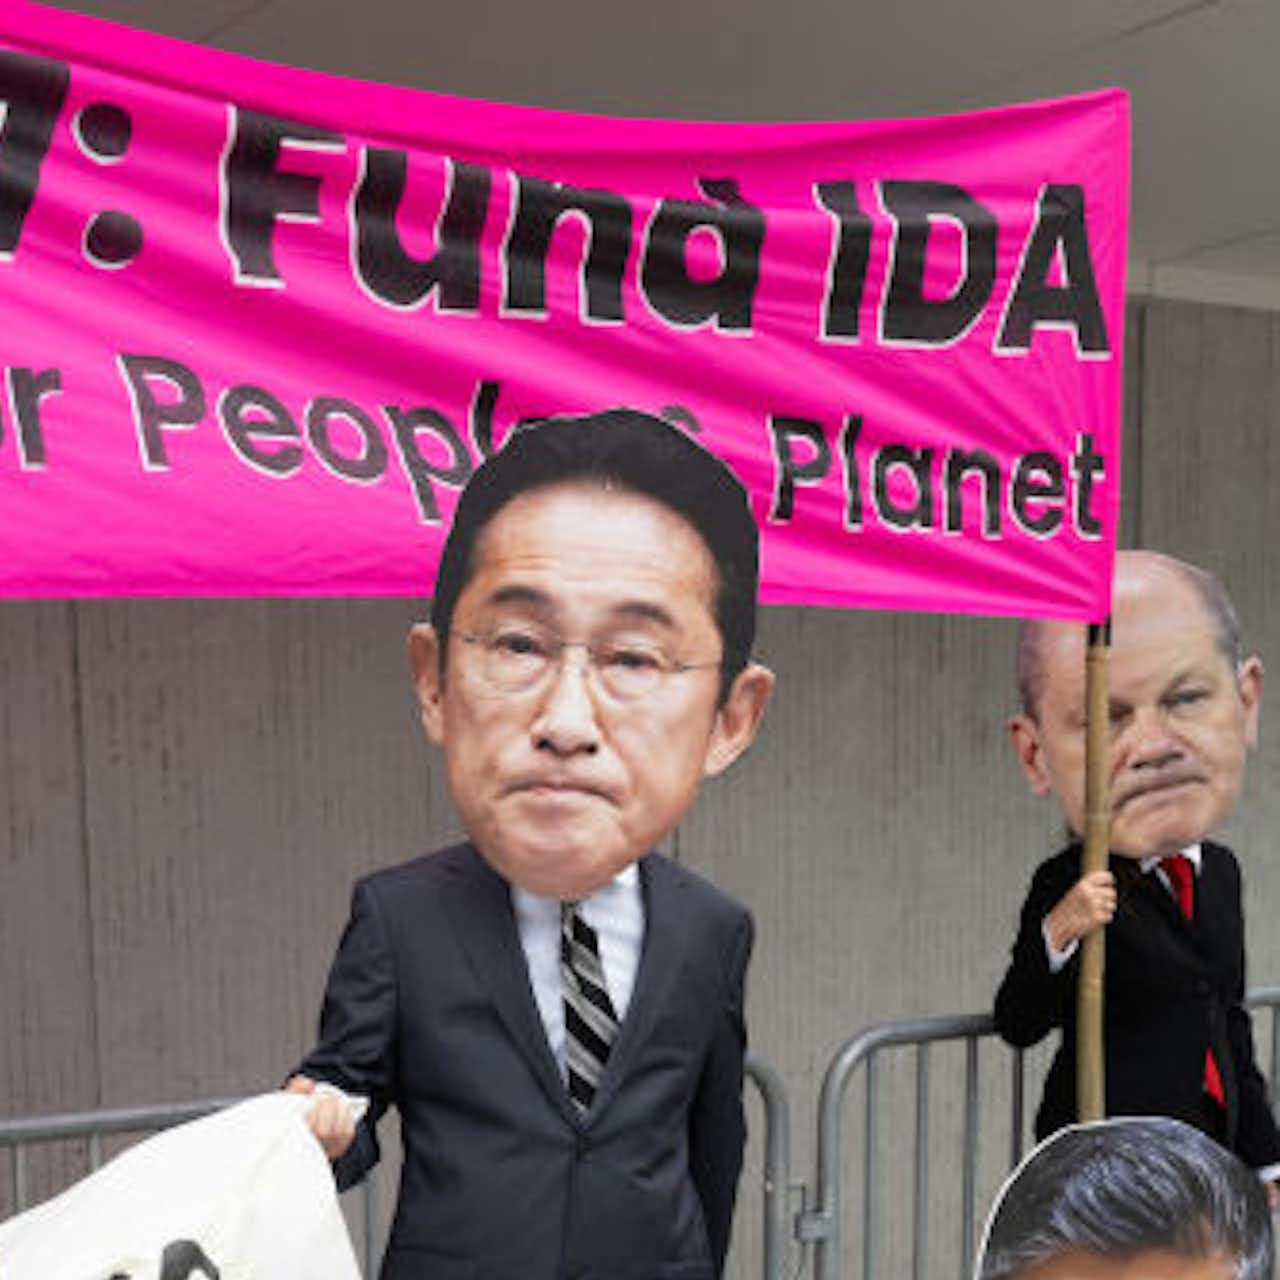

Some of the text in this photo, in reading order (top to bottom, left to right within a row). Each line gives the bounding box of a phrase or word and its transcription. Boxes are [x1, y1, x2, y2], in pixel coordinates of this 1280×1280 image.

[220, 104, 768, 335] Fund
[815, 180, 1112, 360] IDA
[117, 354, 516, 526] Peopl
[767, 414, 1106, 540] Planet
